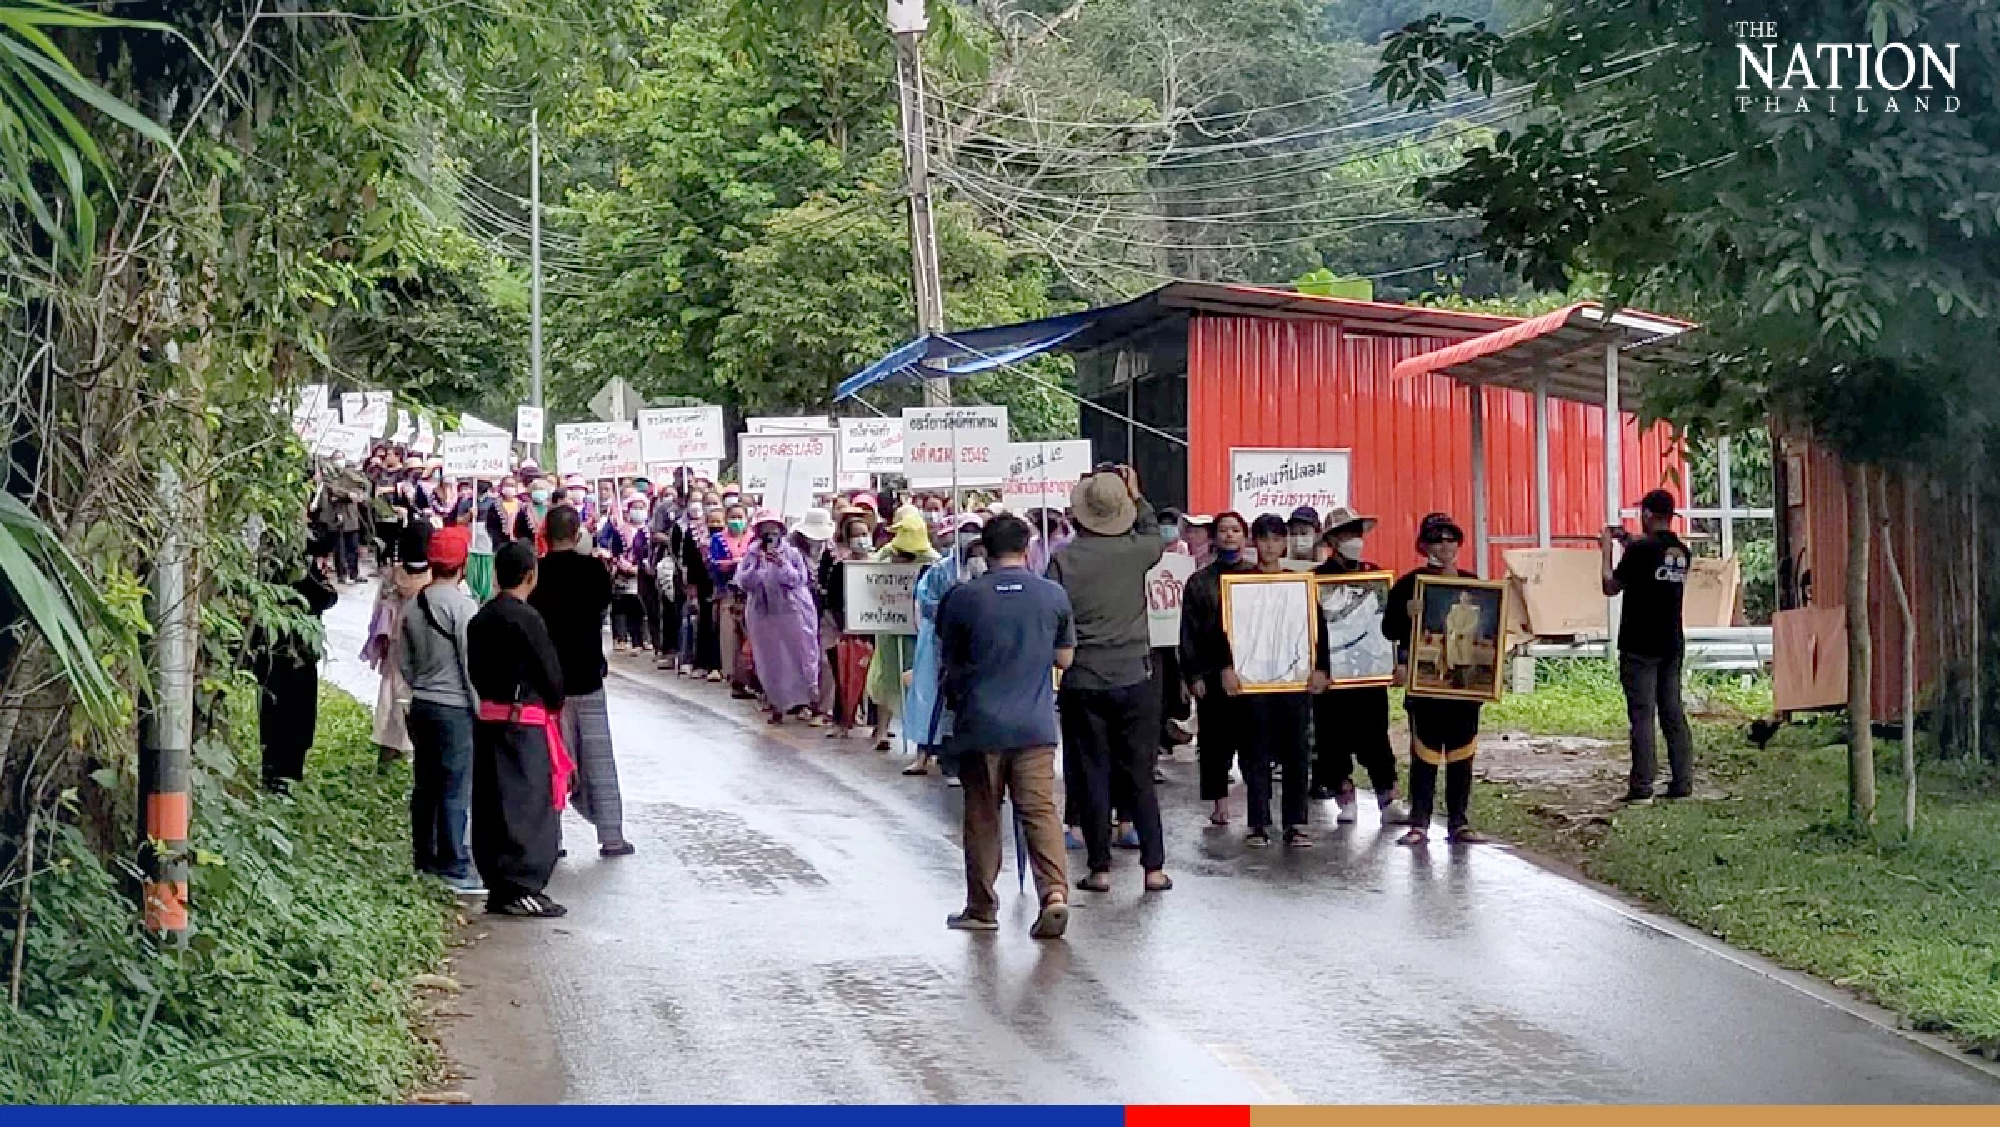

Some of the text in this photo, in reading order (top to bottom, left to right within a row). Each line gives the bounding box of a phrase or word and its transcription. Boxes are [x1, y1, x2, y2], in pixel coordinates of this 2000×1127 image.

[1236, 457, 1327, 492] ใช้แผนที่ปลอม
